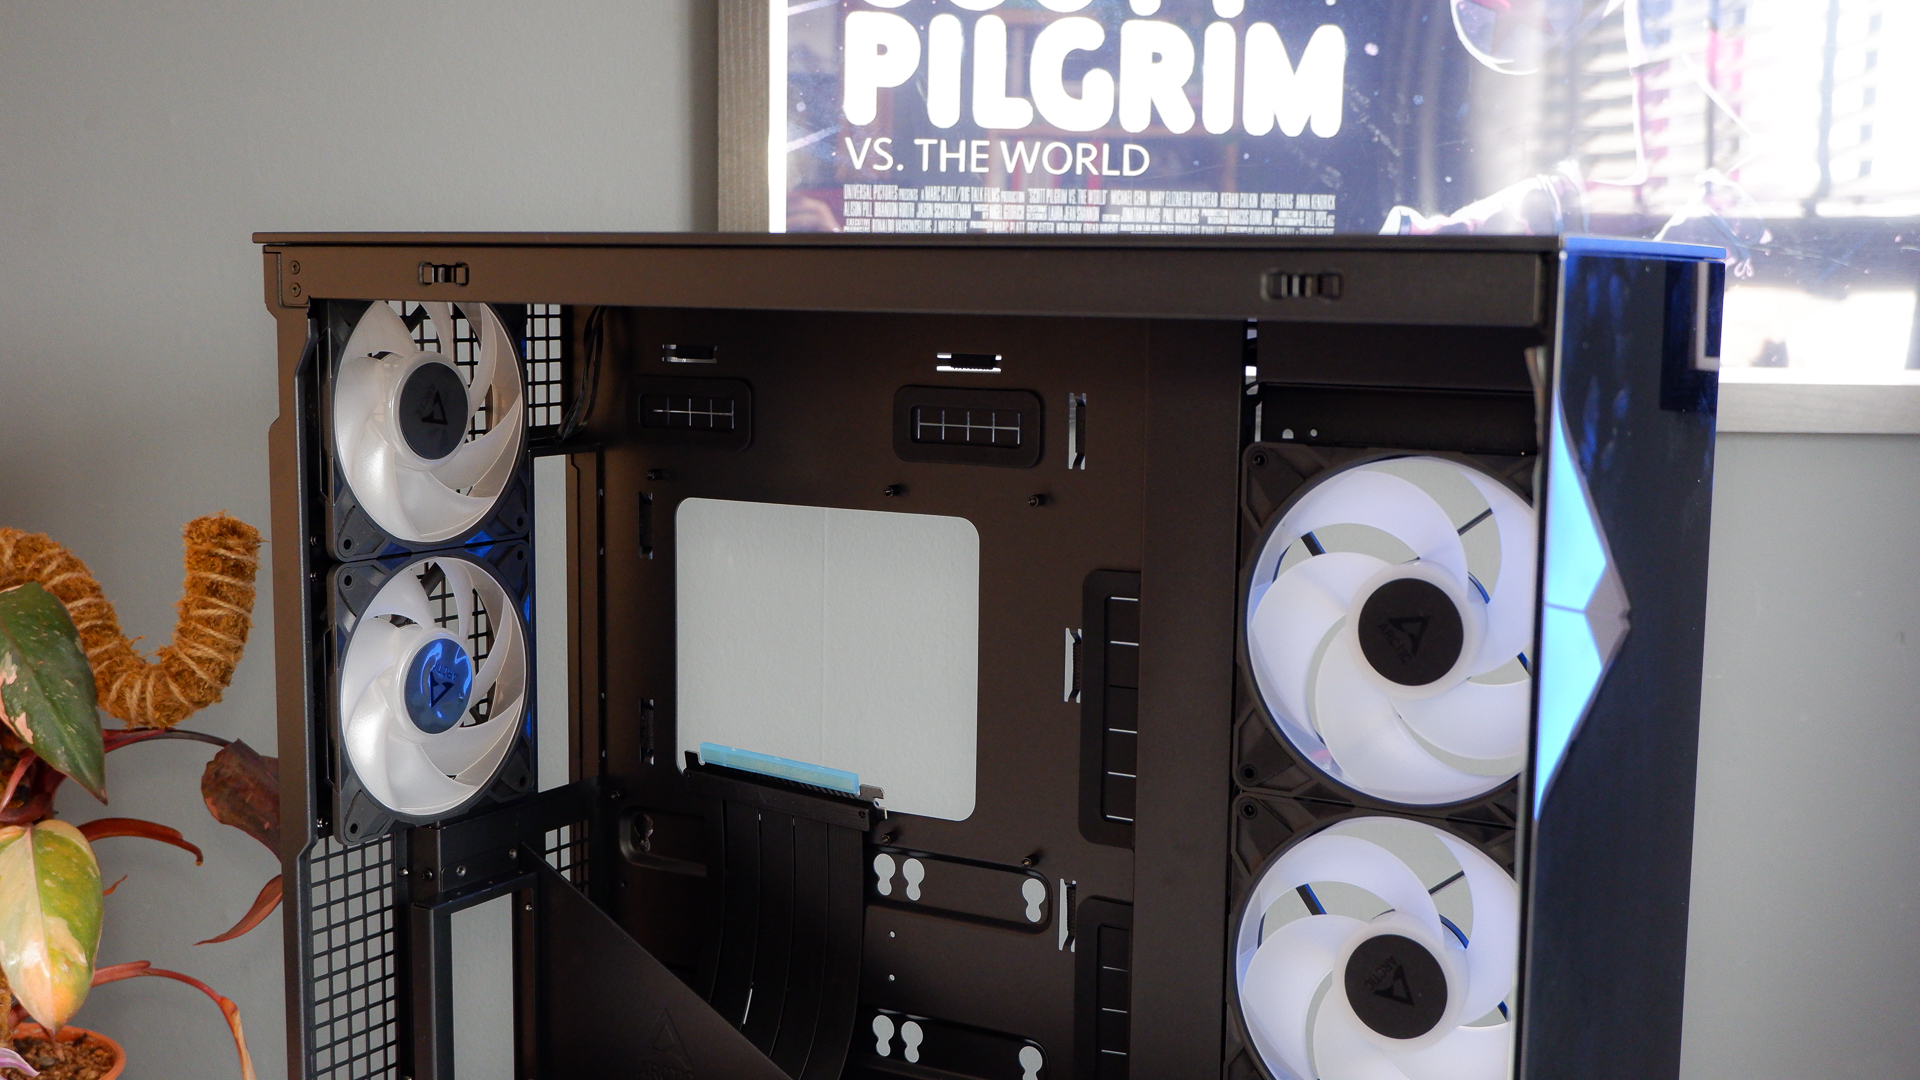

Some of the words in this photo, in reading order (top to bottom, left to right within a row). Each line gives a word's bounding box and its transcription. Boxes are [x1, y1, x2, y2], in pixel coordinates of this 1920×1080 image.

[842, 10, 1346, 139] PILGRIM
[844, 137, 904, 171] VS.
[914, 138, 991, 173] THE
[999, 140, 1151, 176] WORLD
[1377, 624, 1413, 664] ARCTIC
[1364, 955, 1397, 991] ARCTIC
